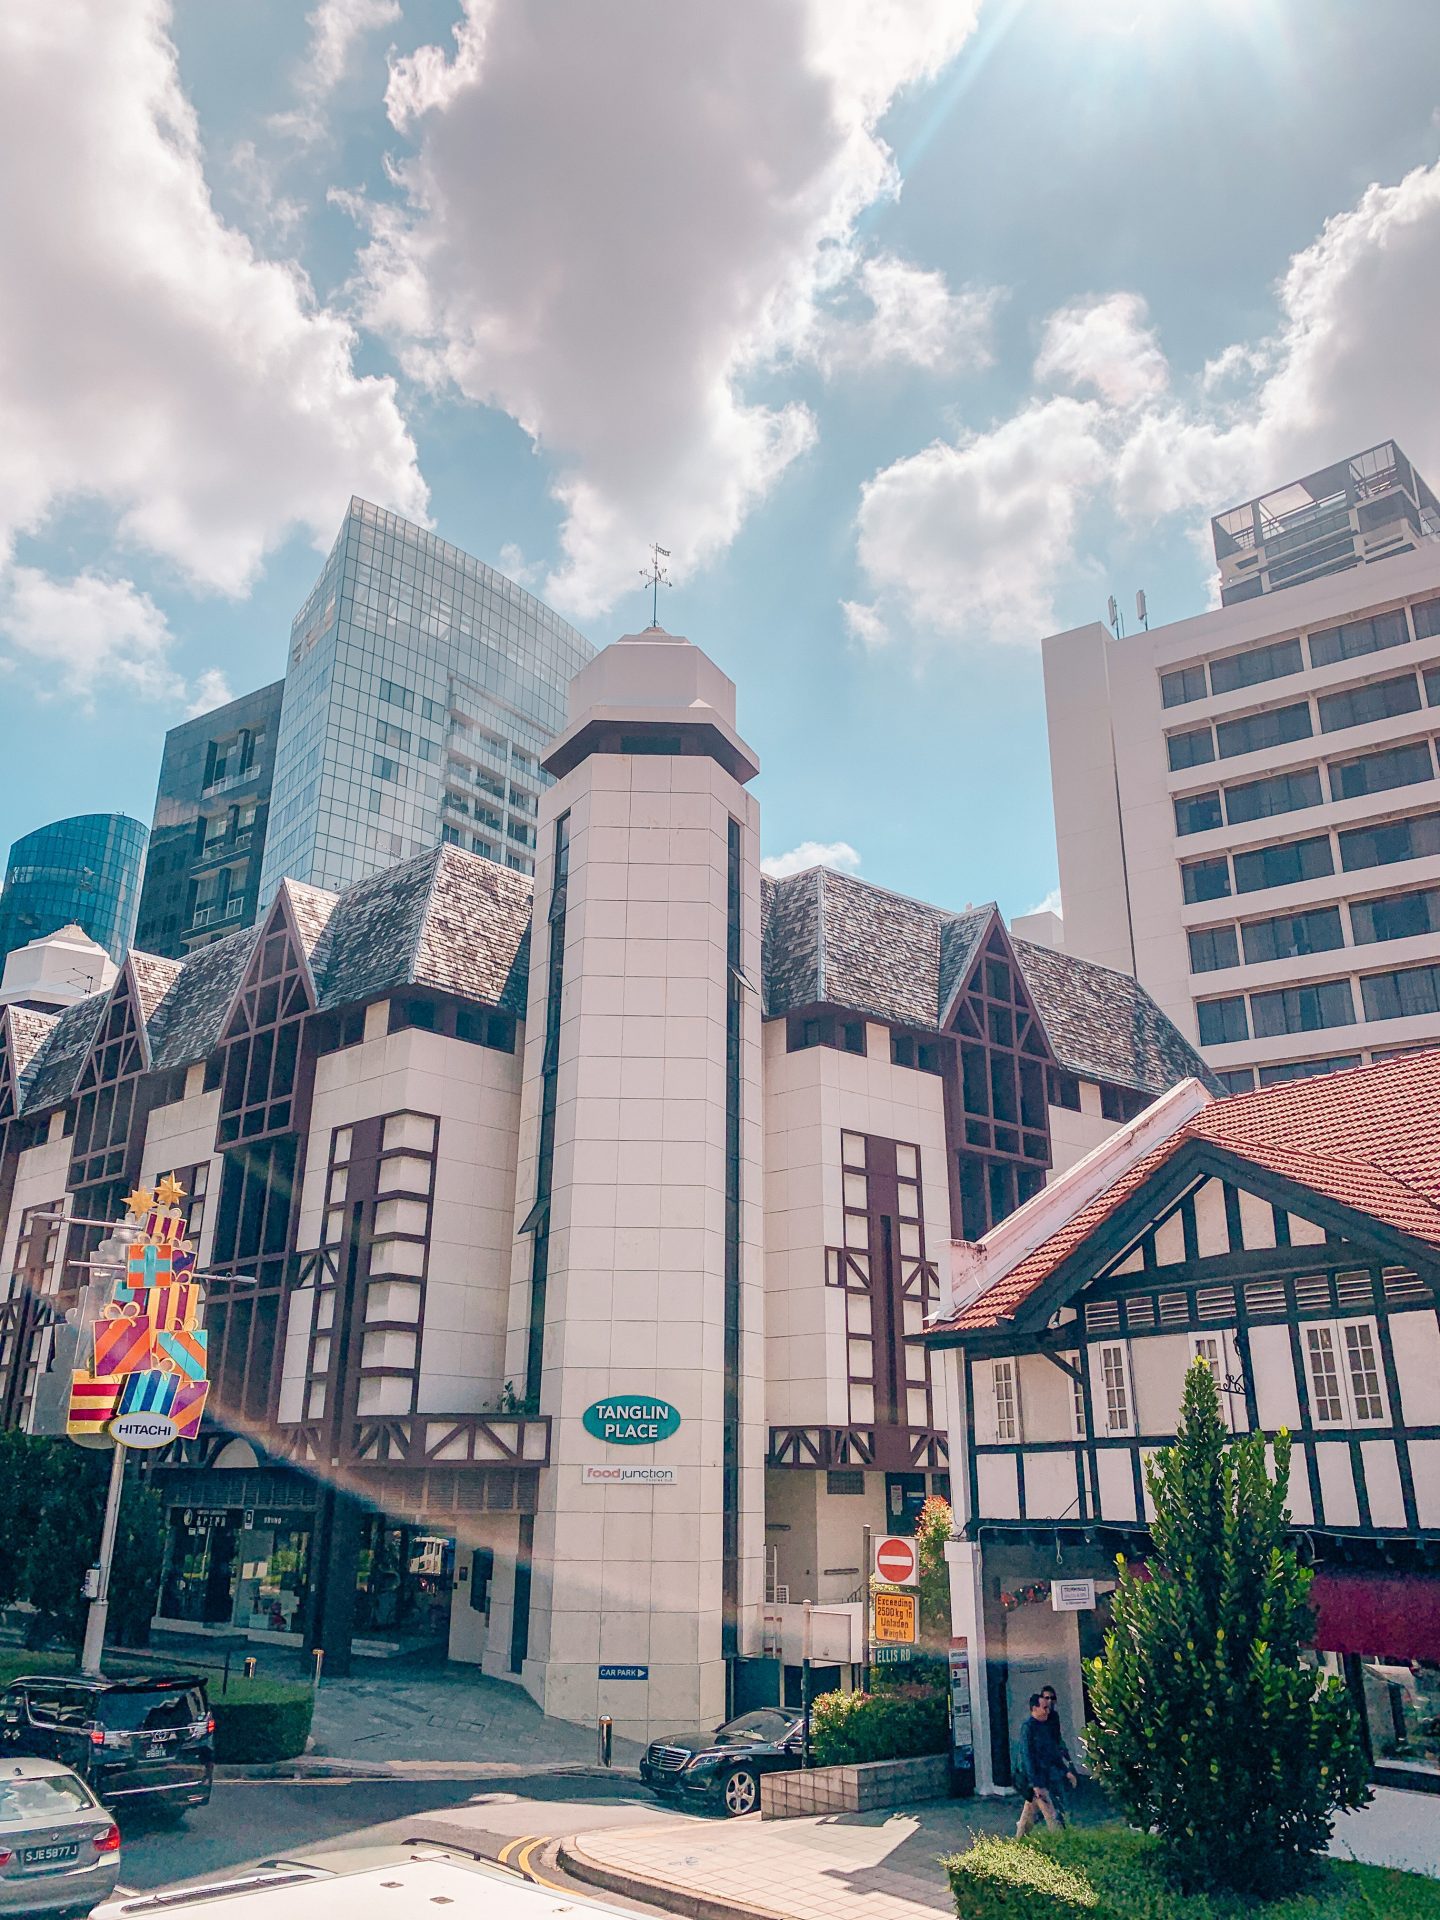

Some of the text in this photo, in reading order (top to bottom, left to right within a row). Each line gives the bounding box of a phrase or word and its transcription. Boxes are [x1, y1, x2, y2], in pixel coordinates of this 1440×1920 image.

[596, 1405, 669, 1420] TANGLIN
[118, 1424, 171, 1436] HITACHI
[604, 1424, 658, 1438] PLACE
[877, 1596, 912, 1610] Exceeding
[880, 1617, 909, 1629] Unladen
[883, 1627, 907, 1640] Weight
[876, 1648, 911, 1664] ELLIS RD
[25, 1845, 78, 1862] SJE5877J
